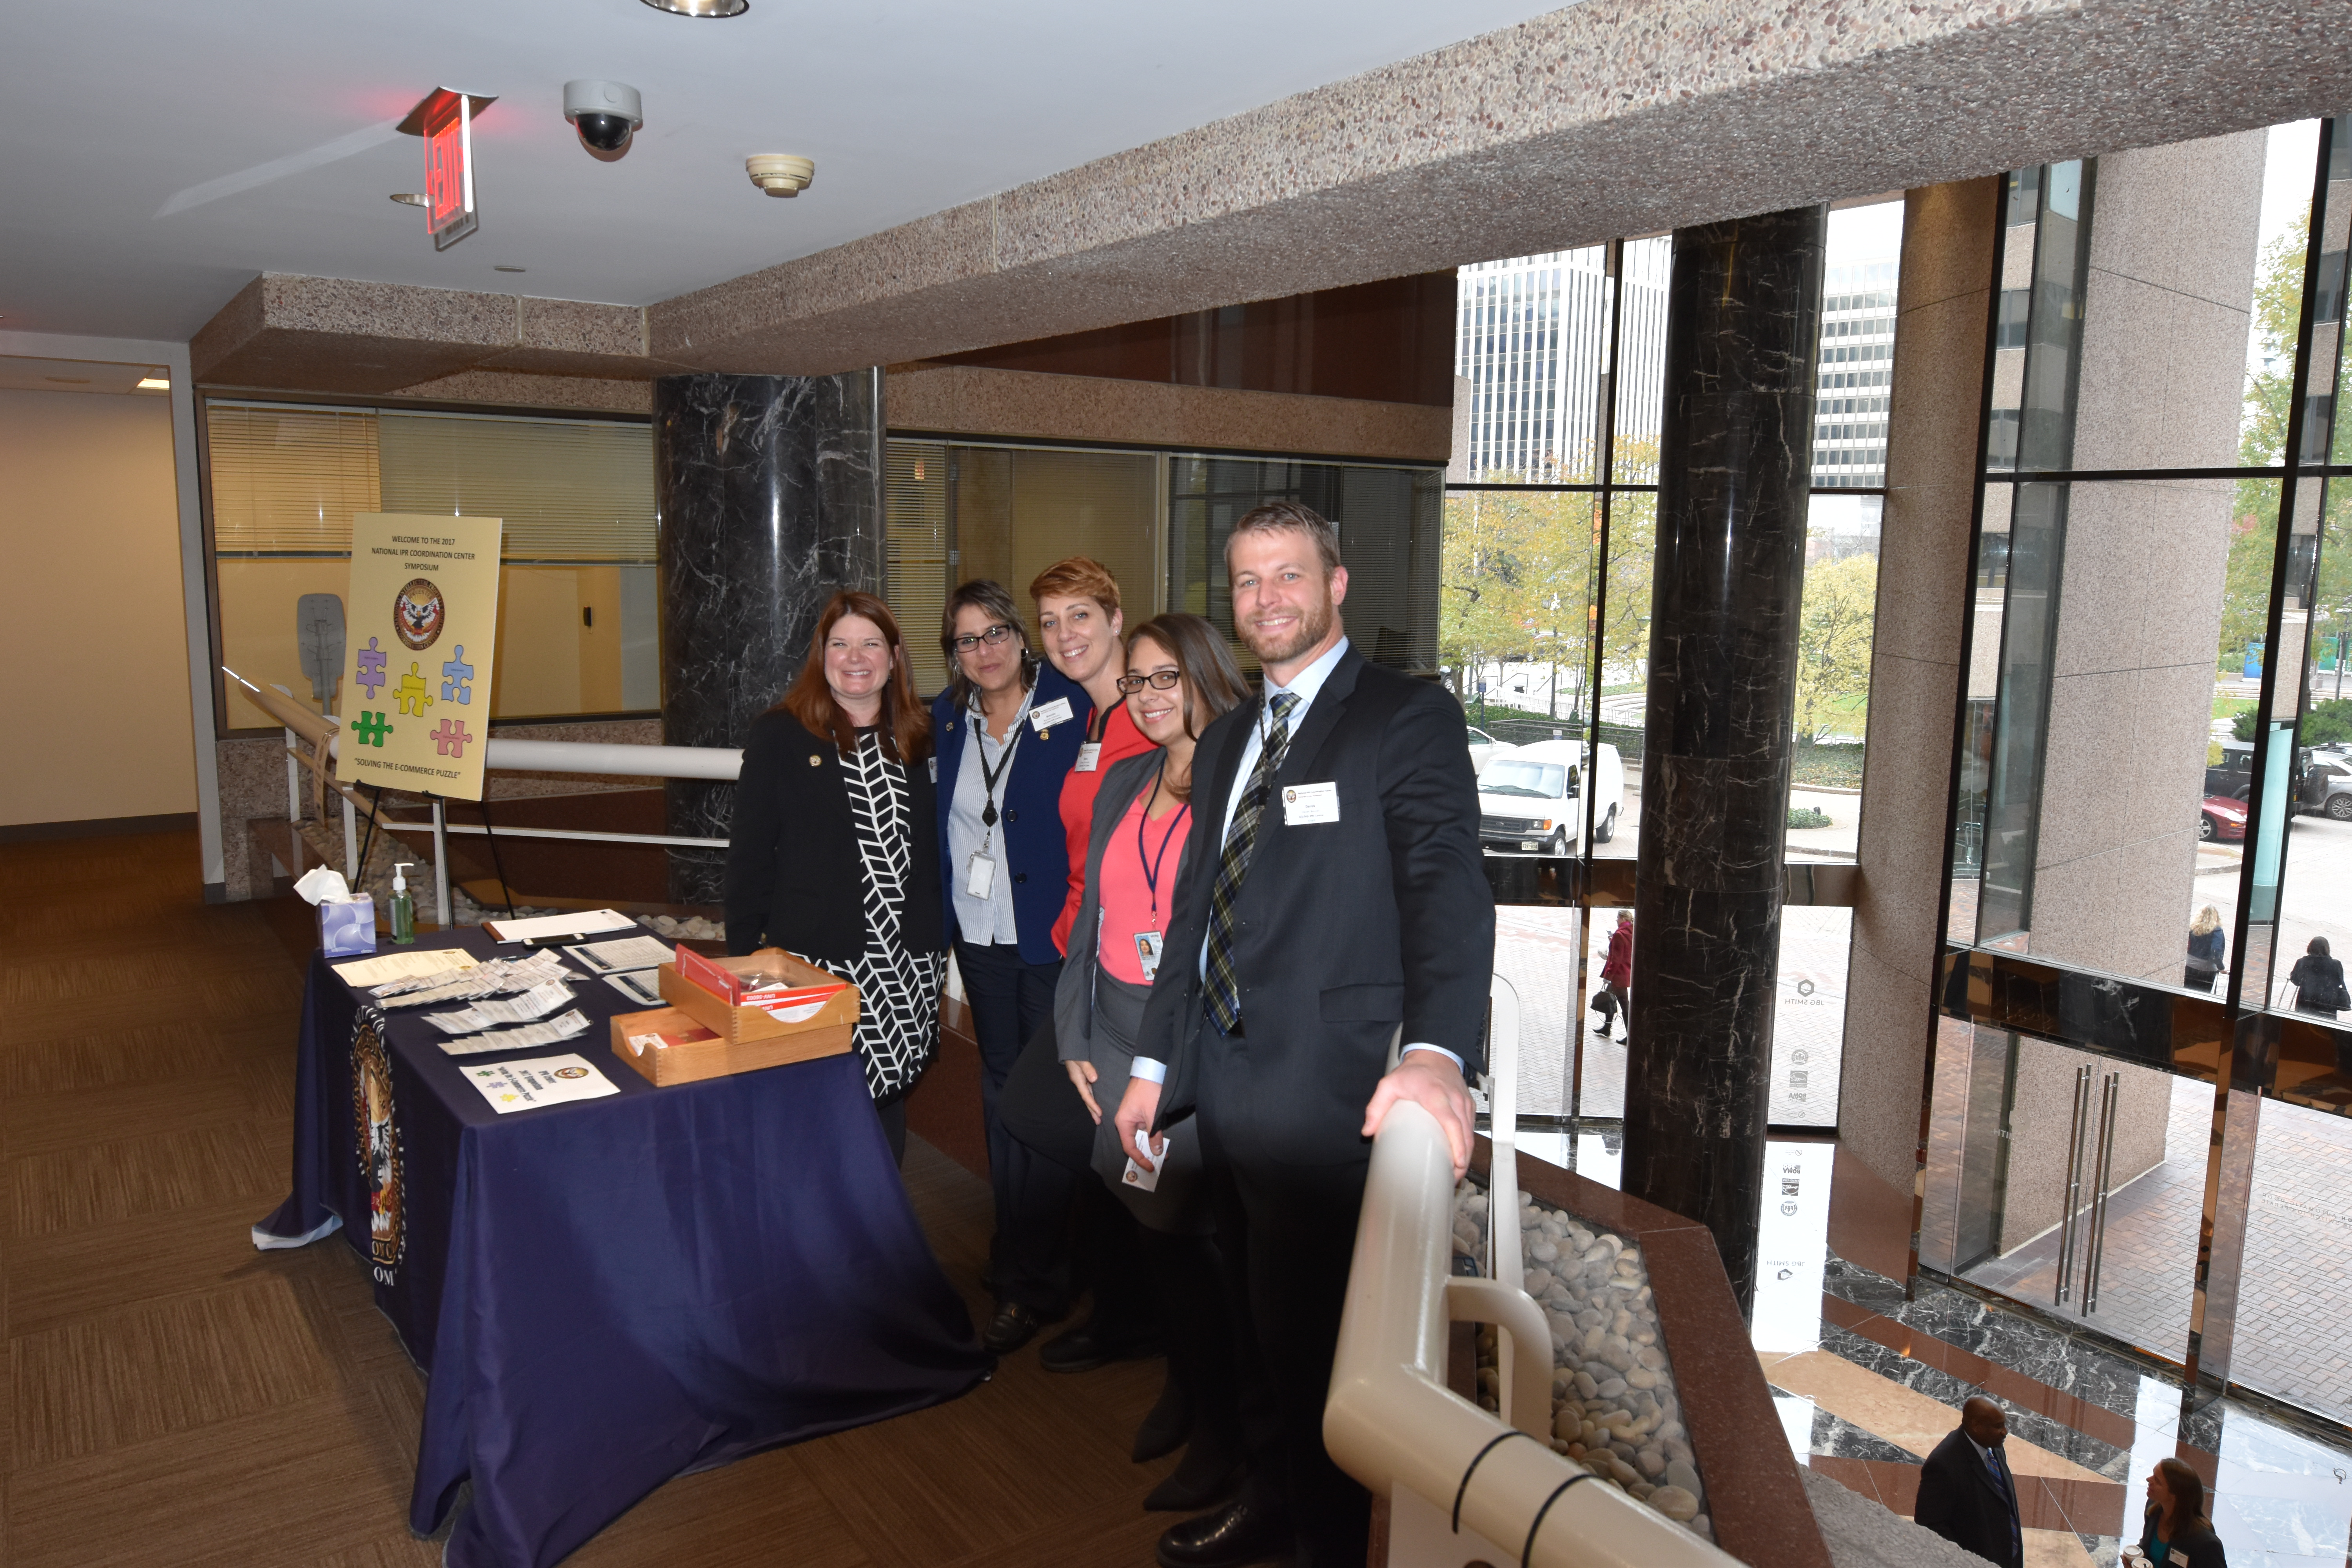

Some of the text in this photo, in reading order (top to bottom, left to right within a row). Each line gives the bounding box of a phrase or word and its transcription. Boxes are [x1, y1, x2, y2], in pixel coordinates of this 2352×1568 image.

[432, 117, 460, 220] EXIT
[392, 535, 419, 544] WELCOME
[410, 550, 452, 559] COORDINATION
[405, 563, 439, 571] SYMPOSIUM
[395, 764, 434, 776] E-COMMERCE
